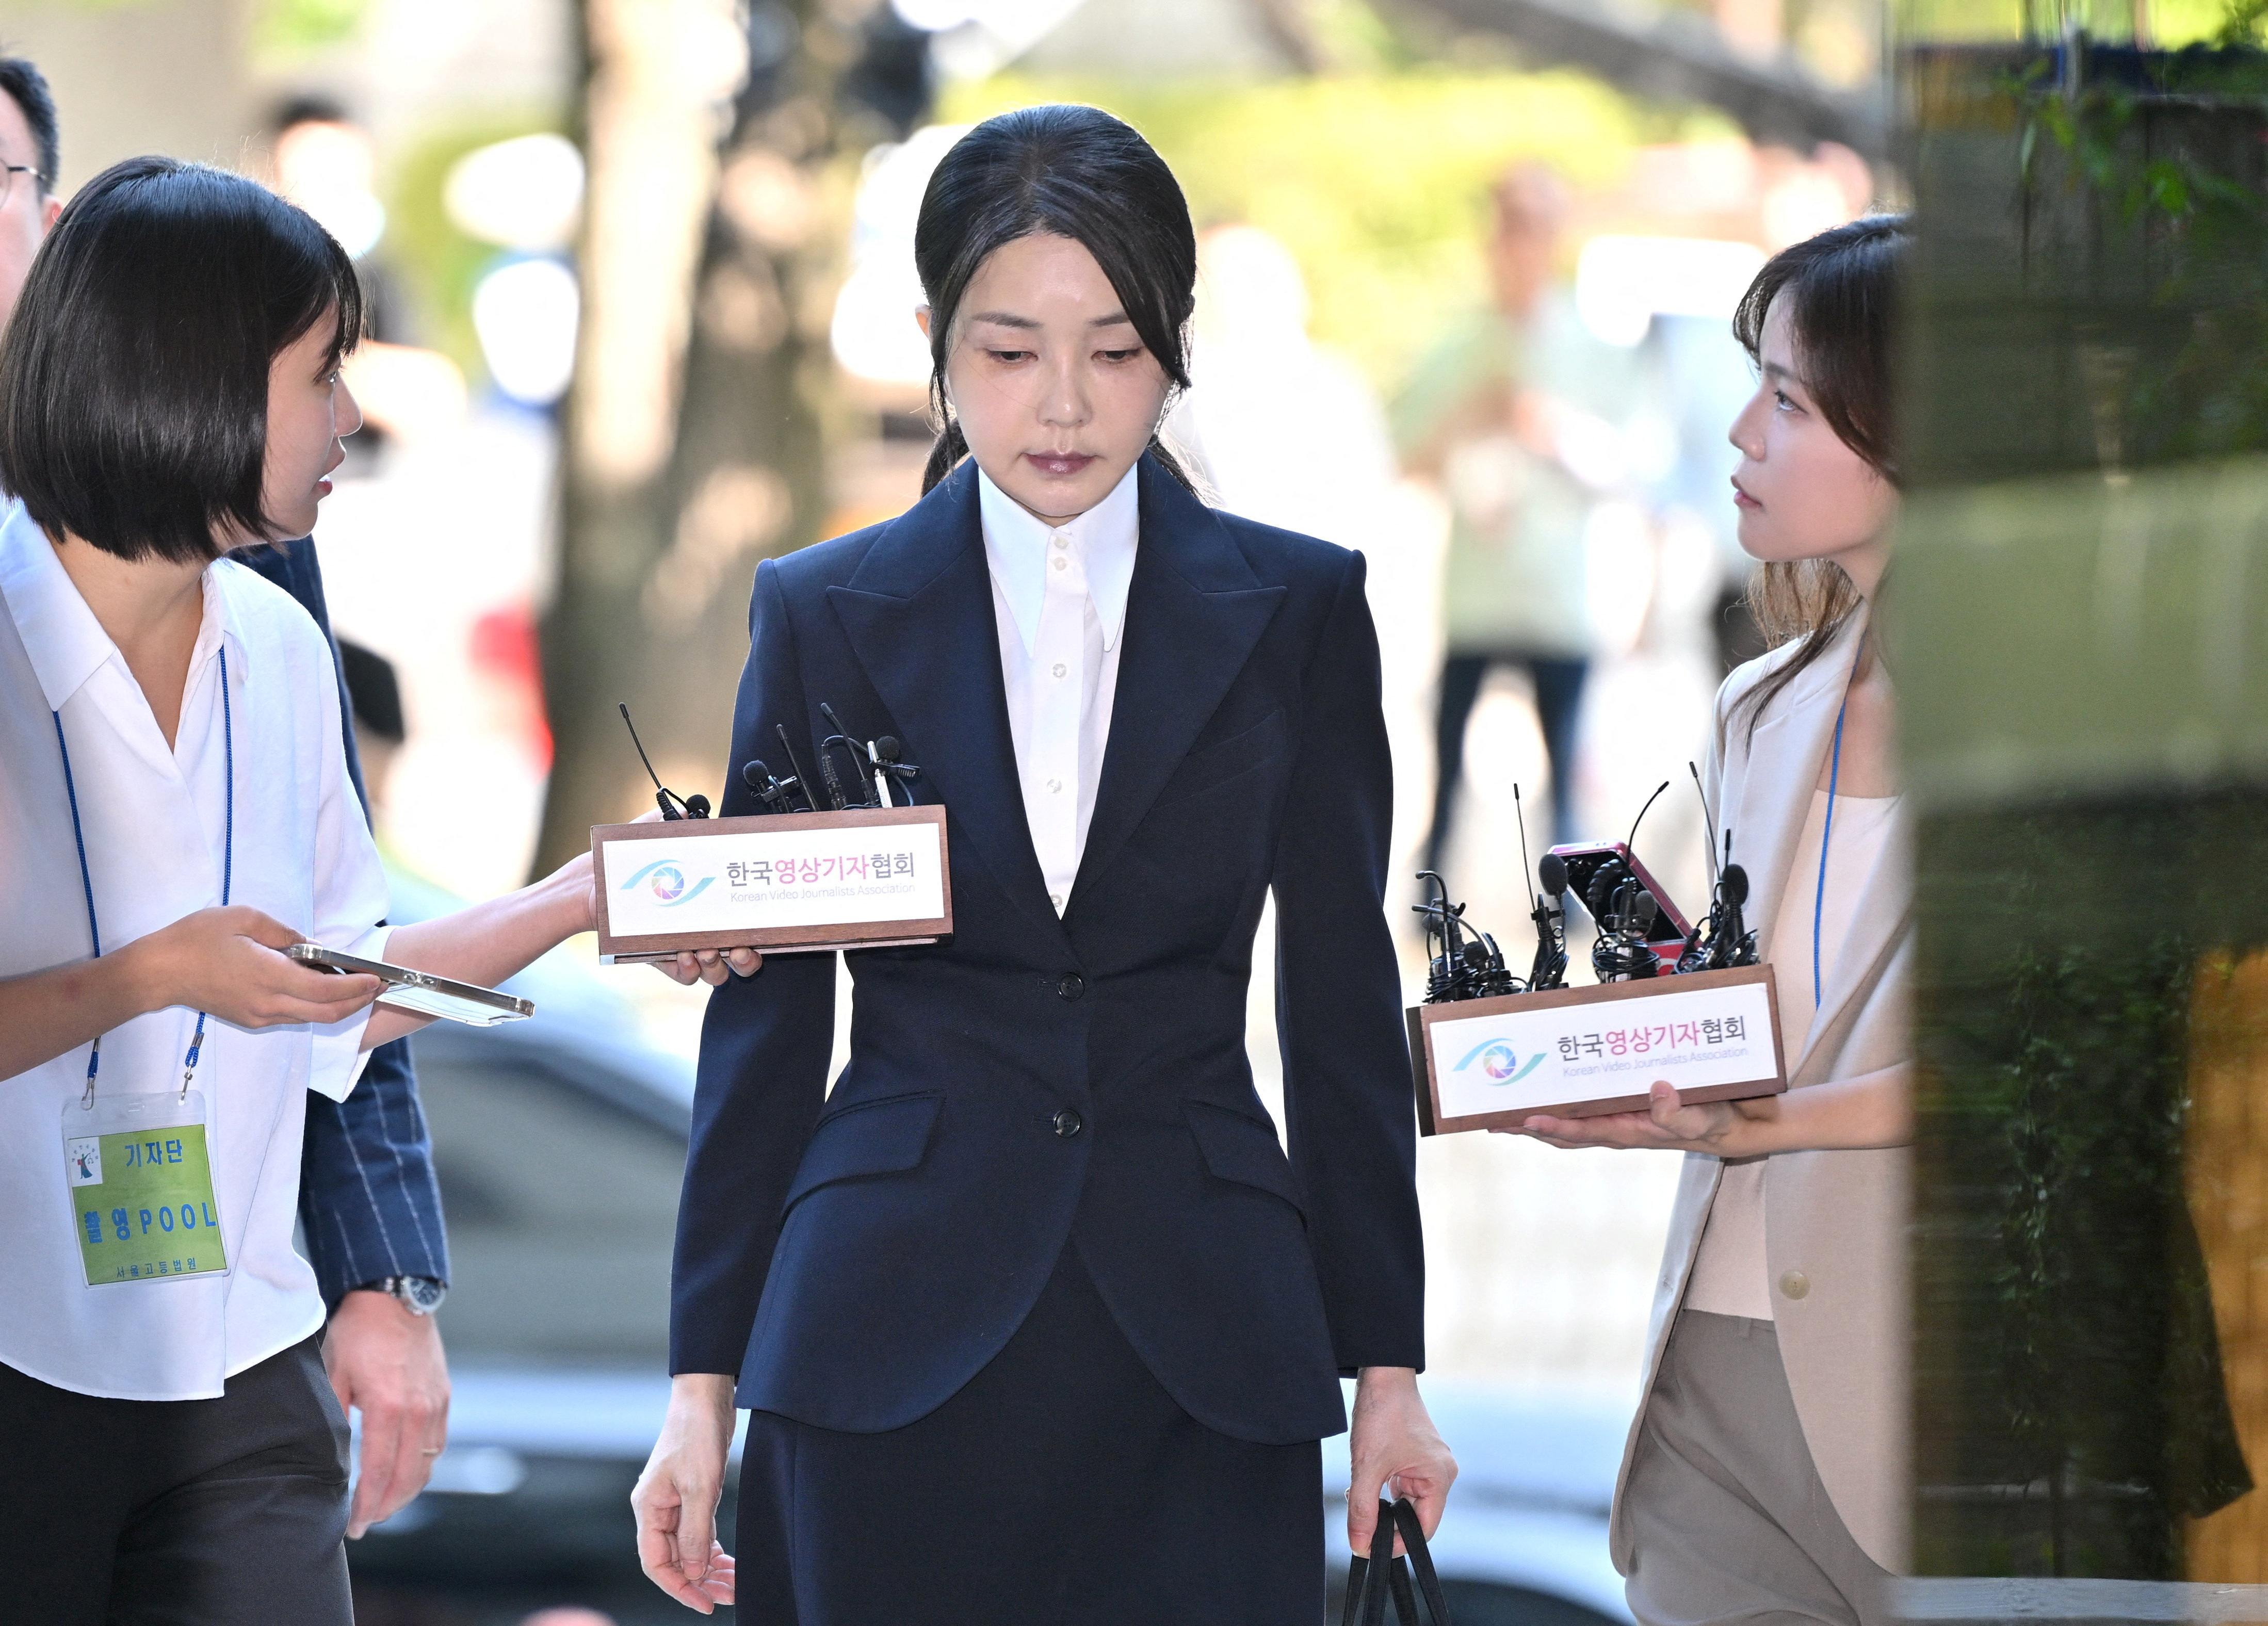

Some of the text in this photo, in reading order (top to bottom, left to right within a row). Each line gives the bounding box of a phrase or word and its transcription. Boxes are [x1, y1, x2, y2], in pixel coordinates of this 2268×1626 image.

[726, 852, 915, 887] 한국영상기자협회
[731, 883, 915, 902] Korean Video Journalists Association
[1557, 1015, 1746, 1062] 한국영상기자협회
[1563, 1047, 1748, 1077] Korean Video Journalists Association
[124, 1139, 183, 1167] 기자단
[117, 1257, 197, 1278] 서울고등법원
